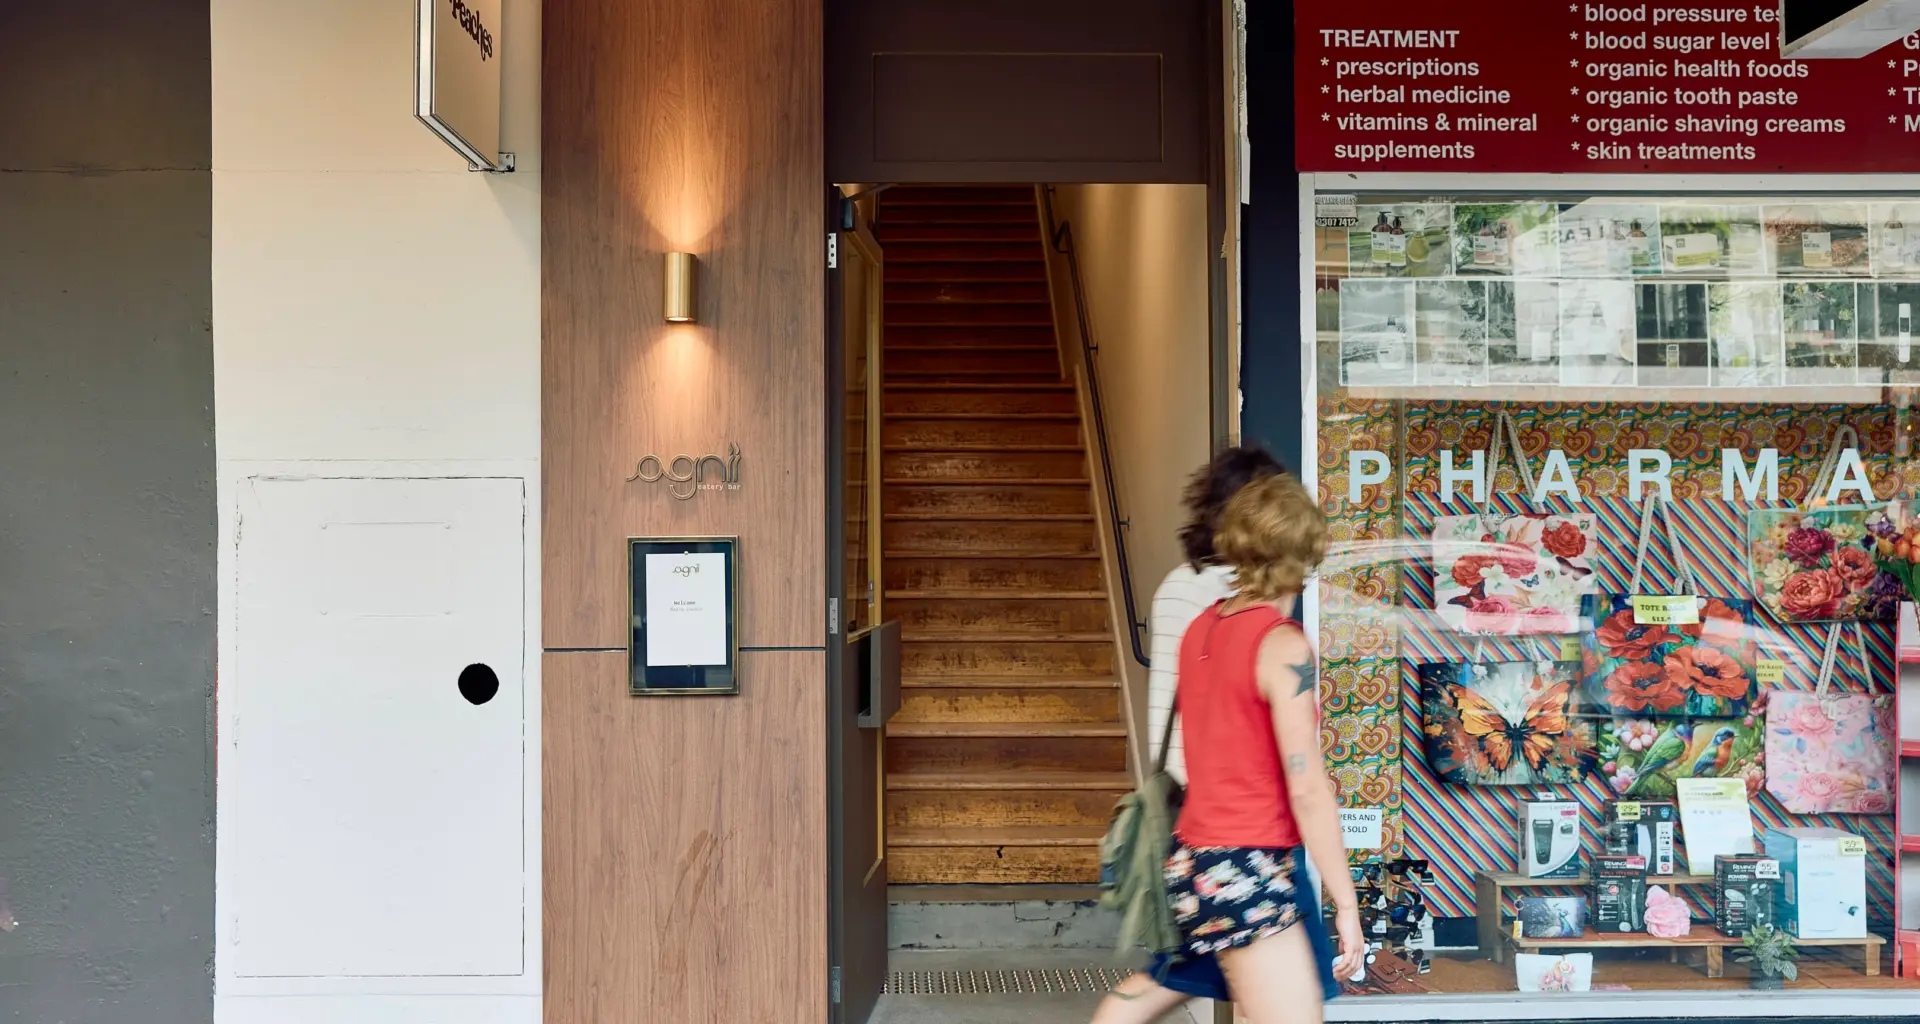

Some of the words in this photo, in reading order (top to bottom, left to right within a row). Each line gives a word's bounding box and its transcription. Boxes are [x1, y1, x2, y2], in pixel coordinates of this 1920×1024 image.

[1586, 4, 1646, 22] blood
[1653, 8, 1748, 26] pressure
[1320, 30, 1460, 48] TREATMENT
[1586, 32, 1646, 50] blood
[1653, 36, 1715, 54] sugar
[1721, 32, 1770, 50] level
[1336, 57, 1480, 80] prescriptions
[1585, 60, 1668, 81] organic
[1674, 60, 1741, 78] health
[1747, 59, 1809, 78] foods
[1903, 60, 1920, 77] P
[1337, 85, 1405, 103] herbal
[1412, 86, 1511, 104] medicine
[1586, 87, 1668, 108] organic
[1674, 87, 1731, 105] tooth
[1738, 88, 1798, 109] paste
[1337, 113, 1429, 131] vitamins
[1435, 113, 1451, 131] &
[1457, 114, 1537, 132] mineral
[1587, 114, 1669, 137] organic
[1675, 114, 1758, 137] shaving
[1765, 119, 1846, 133] creams
[1334, 141, 1475, 162] supplements
[1587, 142, 1631, 160] skin
[1638, 142, 1756, 160] treatments
[1348, 448, 1875, 503] PHARMA
[697, 483, 724, 492] eatery
[1358, 813, 1376, 821] AND
[1347, 825, 1368, 833] SOLD
